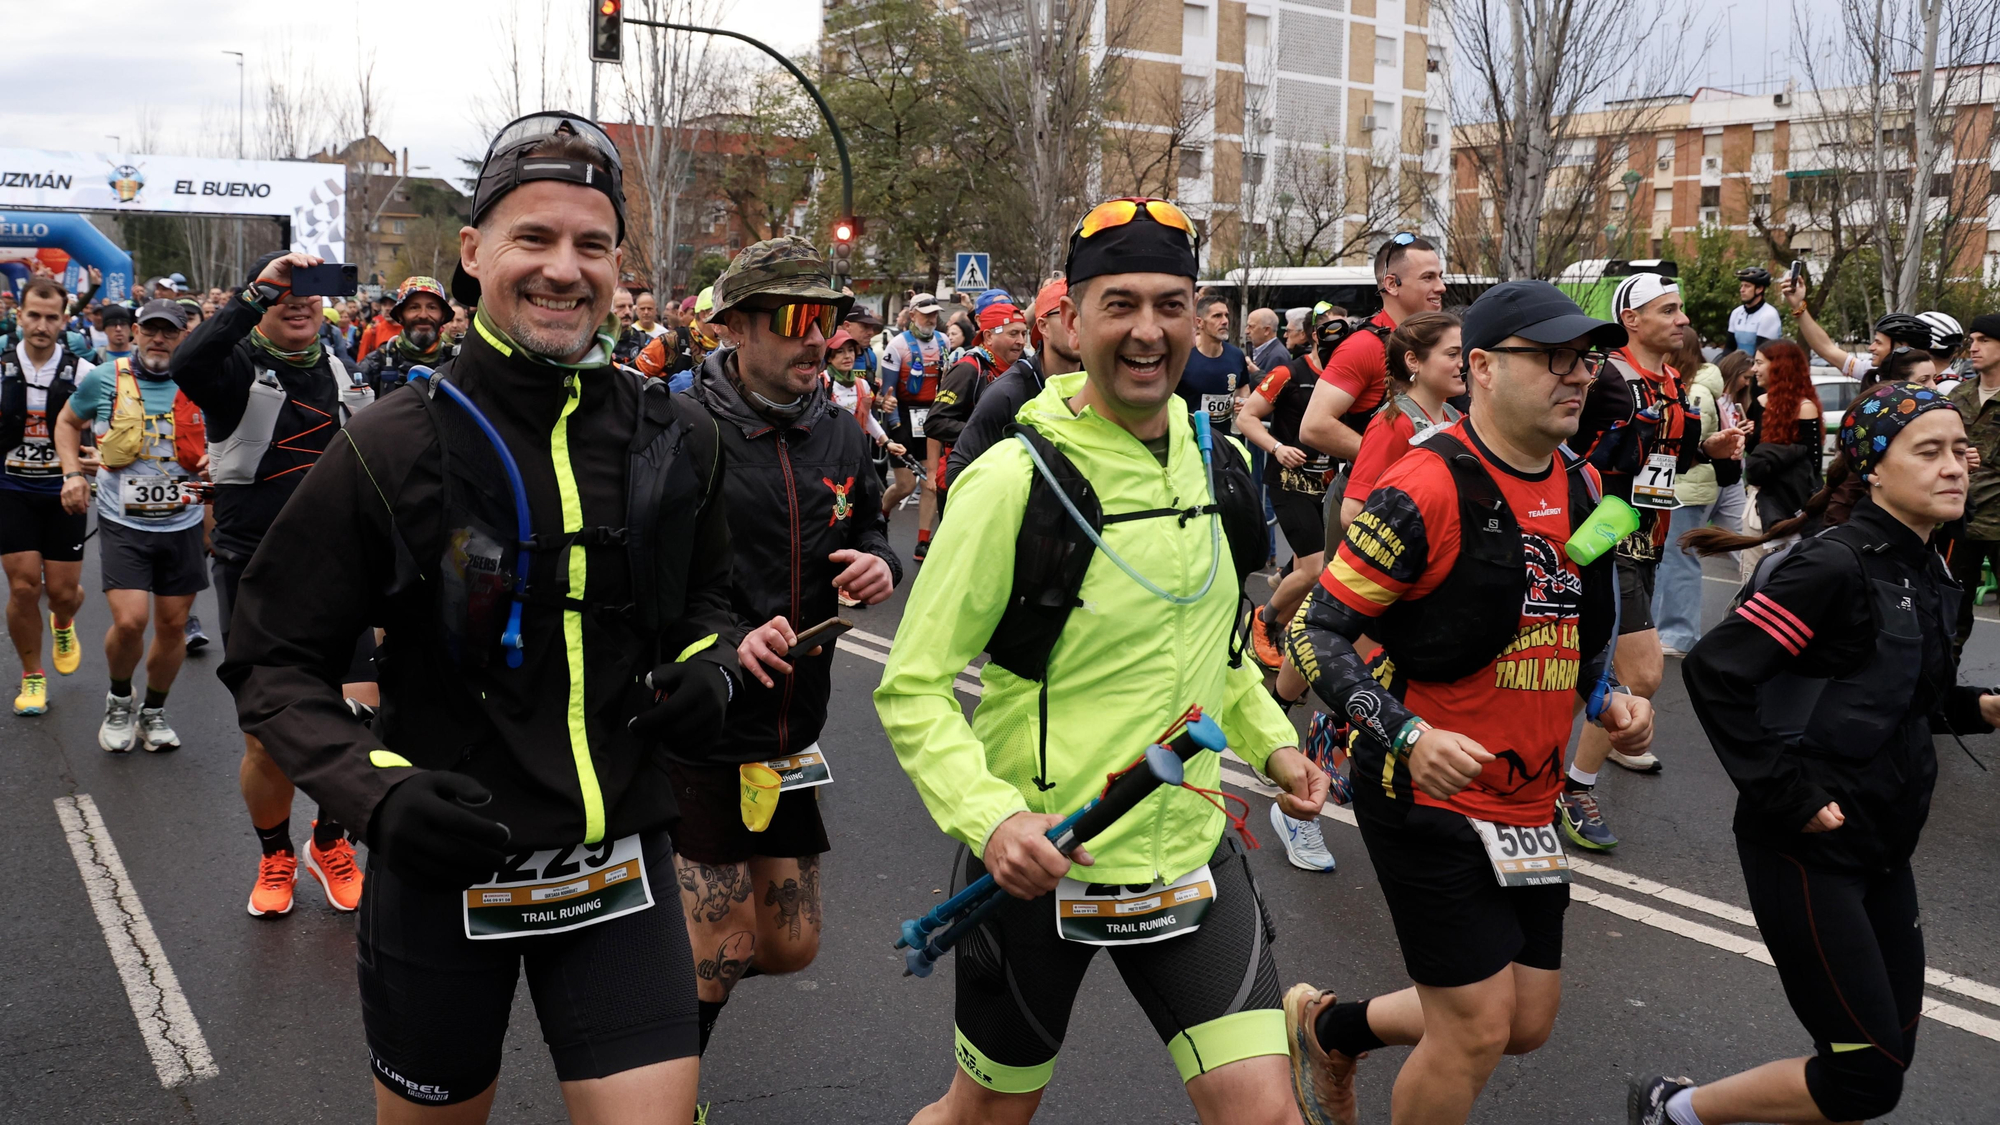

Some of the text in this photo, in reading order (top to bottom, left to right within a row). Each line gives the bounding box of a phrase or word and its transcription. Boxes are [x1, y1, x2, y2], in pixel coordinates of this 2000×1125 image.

[174, 180, 271, 198] EL BUENO
[1208, 401, 1231, 412] 608
[16, 445, 55, 461] 426
[1648, 467, 1673, 487] 71
[135, 485, 180, 502] 303
[1377, 522, 1406, 556] LOKAS
[1355, 531, 1396, 570] KÓRDOBA
[1294, 635, 1321, 683] LOKAS
[1495, 658, 1539, 691] TRAIL
[781, 771, 804, 783] UNING
[1493, 823, 1557, 857] 566
[1526, 877, 1541, 885] TRAIL
[522, 898, 602, 923] TRAIL RUNING
[1106, 914, 1177, 933] TRAIL RUNING
[376, 1059, 449, 1094] LURBEL
